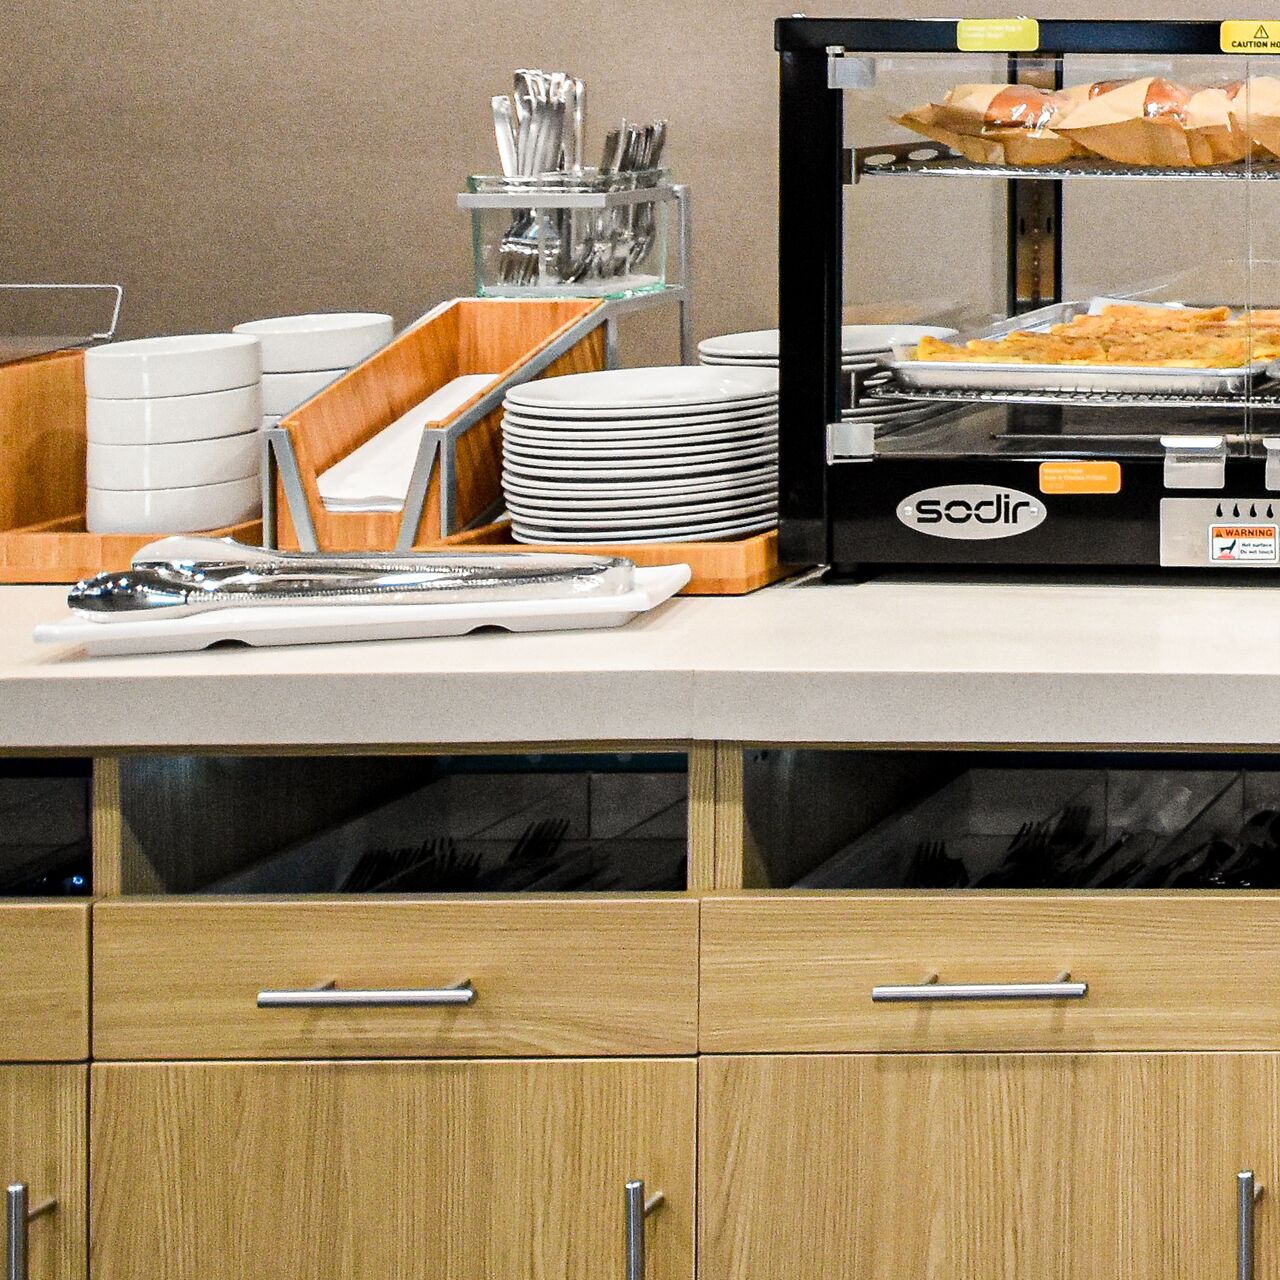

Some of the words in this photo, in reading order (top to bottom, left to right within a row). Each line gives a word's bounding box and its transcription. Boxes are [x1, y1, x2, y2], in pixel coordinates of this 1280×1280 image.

[1231, 40, 1268, 48] CAUTION
[915, 493, 1030, 524] sodir
[1225, 528, 1273, 537] WARNING
